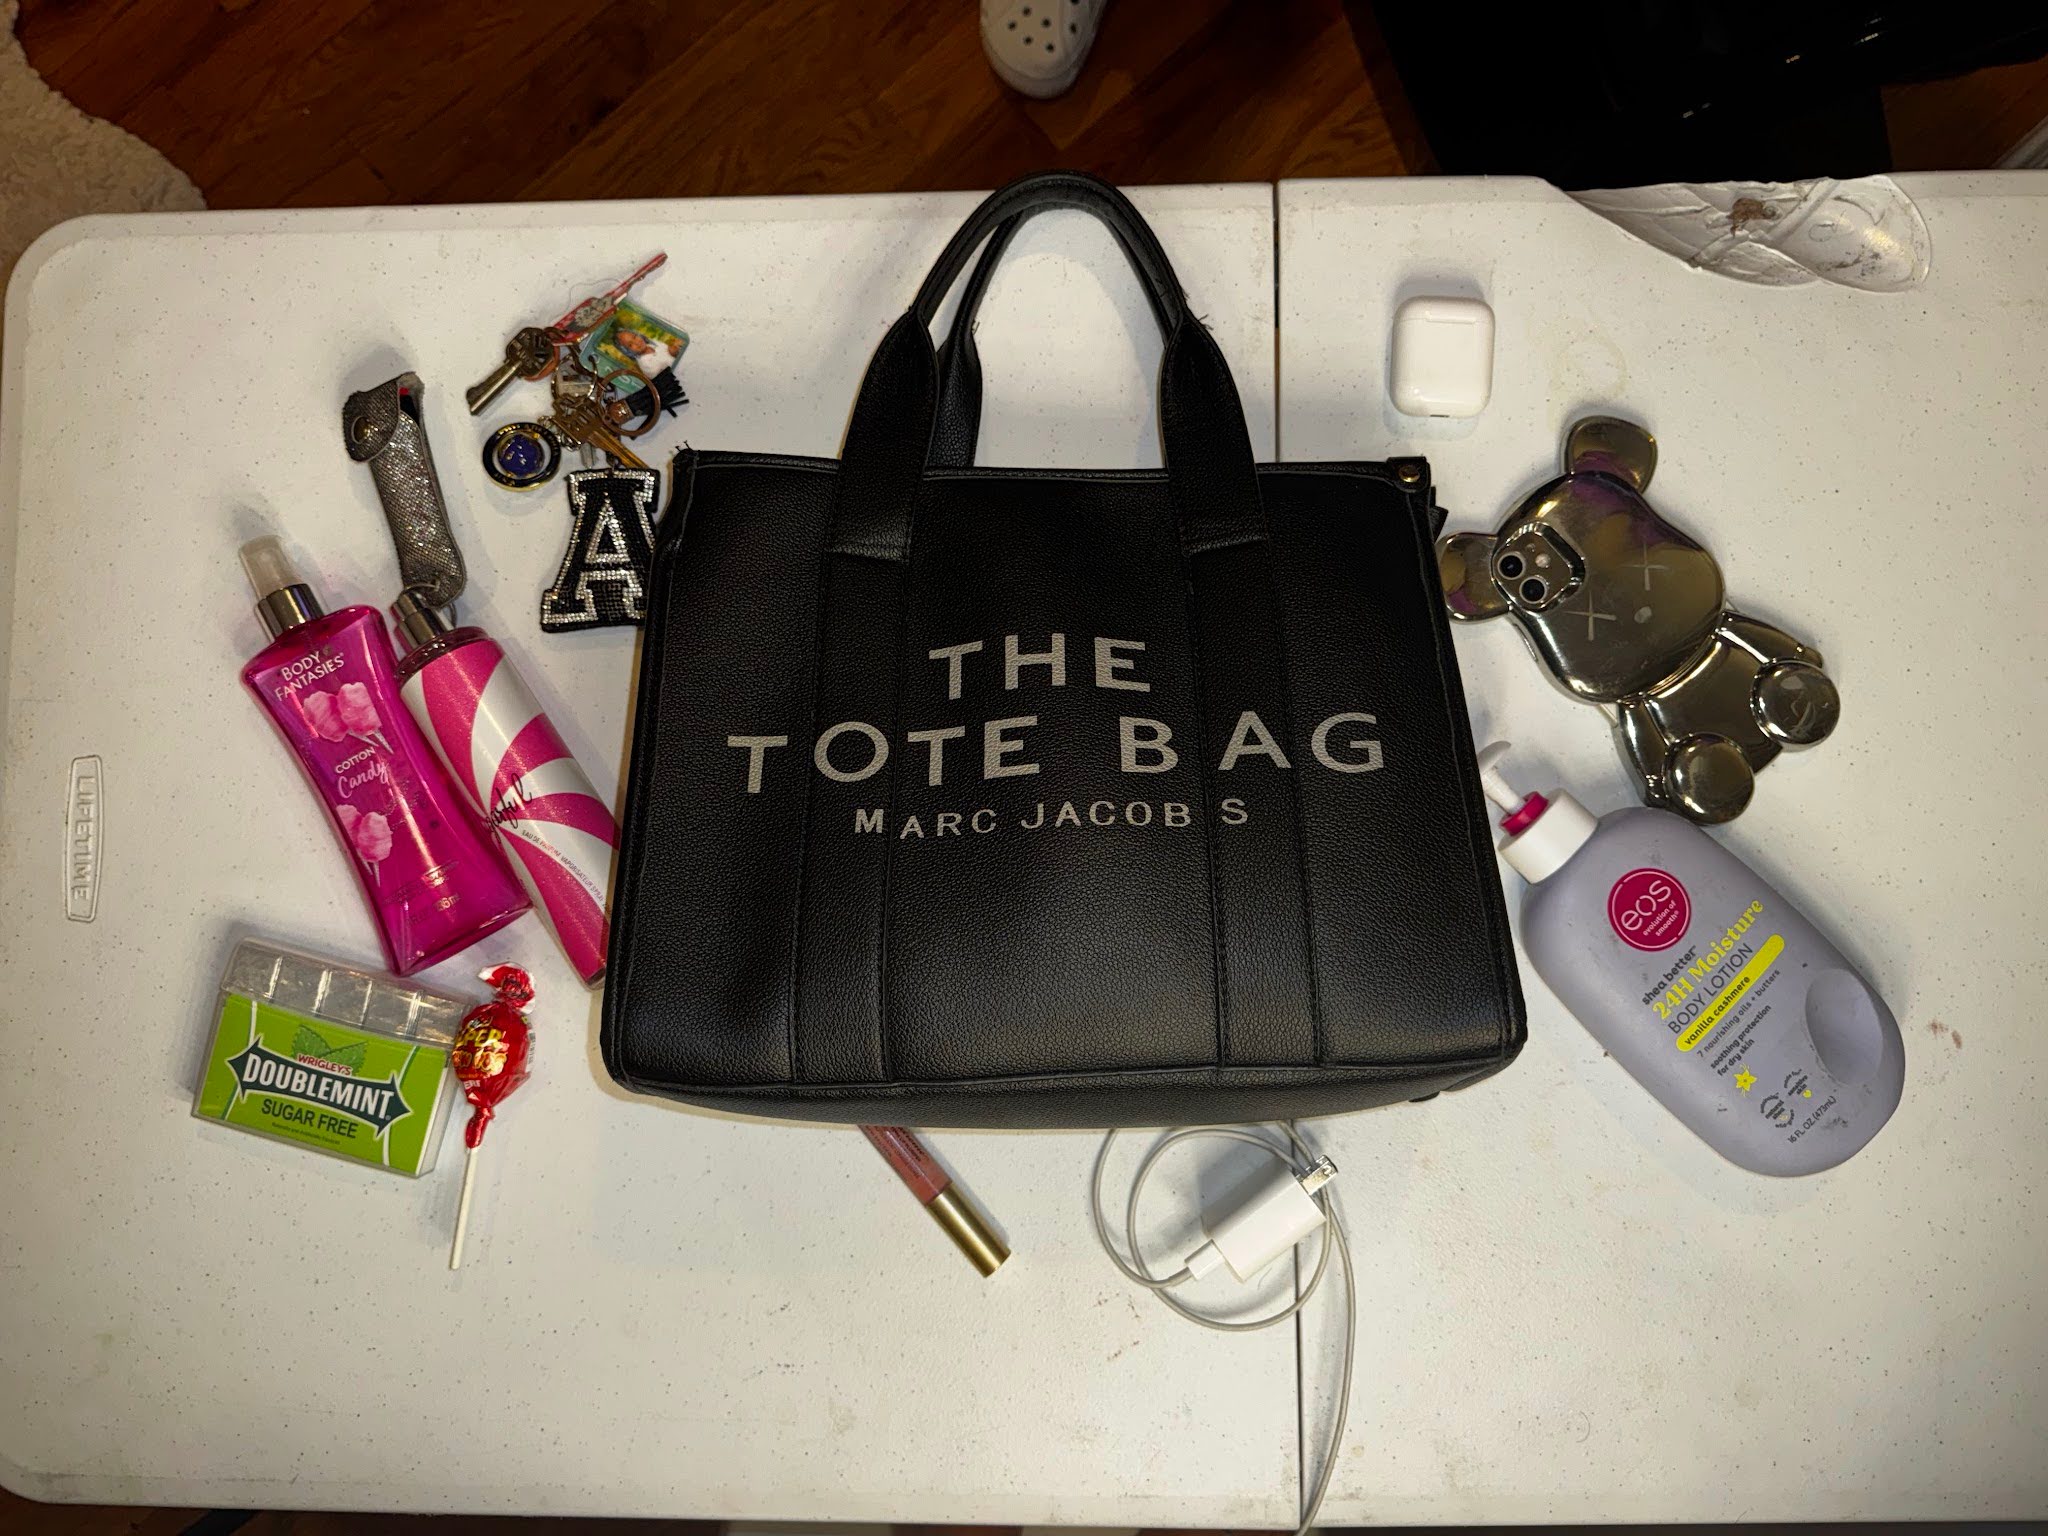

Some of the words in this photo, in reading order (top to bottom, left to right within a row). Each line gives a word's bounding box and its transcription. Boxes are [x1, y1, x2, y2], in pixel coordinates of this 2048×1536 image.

[540, 470, 661, 630] A
[273, 656, 345, 702] FANTASIES
[280, 651, 322, 682] BODY
[929, 633, 1151, 700] THE
[335, 746, 376, 774] COTTON
[727, 714, 1041, 794] TOTE
[1119, 710, 1385, 774] BAG
[338, 760, 389, 799] Candy
[71, 775, 97, 901] LIFETIME
[855, 807, 997, 840] MARC
[1020, 798, 1249, 830] JACOBS
[1621, 880, 1671, 931] eos
[1643, 907, 1670, 937] evolution
[1668, 900, 1677, 911] of
[1653, 977, 1694, 1020] 24H
[1688, 900, 1764, 983] Moisture
[1642, 980, 1667, 1006] shea
[1668, 993, 1706, 1034] BODY
[1703, 943, 1753, 997] LOTION
[1685, 1015, 1715, 1045] vanilla
[1713, 976, 1751, 1017] cashmere
[1697, 1050, 1704, 1058] 7
[1704, 1015, 1740, 1053] nourishing
[1738, 1001, 1752, 1016] oils
[1755, 969, 1781, 997] butters
[1711, 1039, 1740, 1069] soothing
[1738, 1004, 1771, 1041] protection
[297, 1054, 352, 1076] WRIGLEY'S
[1717, 1064, 1730, 1077] for
[1728, 1052, 1742, 1068] dry
[1741, 1038, 1755, 1055] skin
[242, 1053, 395, 1120] DOUBLEMINT
[261, 1098, 315, 1127] SUGAR
[316, 1114, 359, 1139] FREE
[1787, 1134, 1797, 1143] 16
